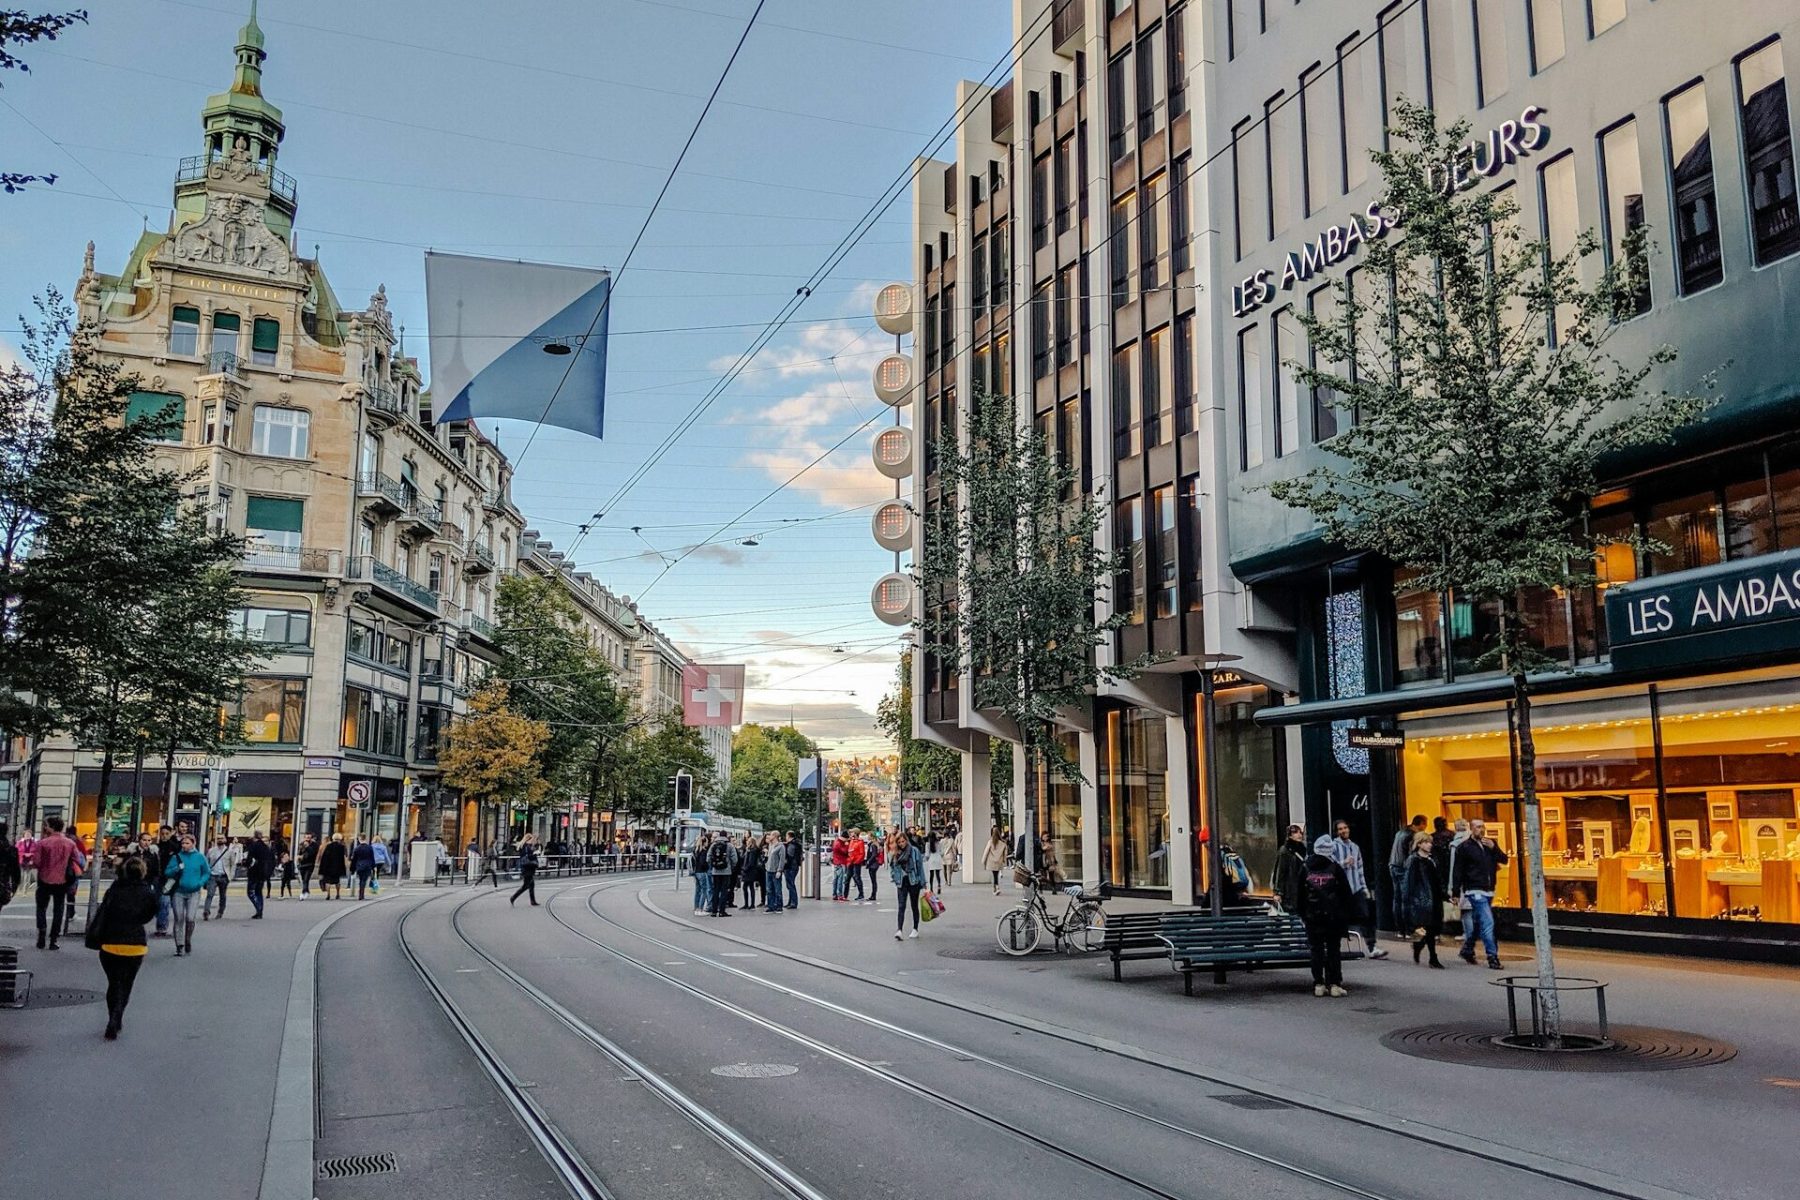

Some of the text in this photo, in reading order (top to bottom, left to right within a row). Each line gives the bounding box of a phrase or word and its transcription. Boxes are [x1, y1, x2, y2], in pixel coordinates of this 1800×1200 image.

[1231, 104, 1546, 317] LES AMBASSDEURS
[882, 288, 905, 610] IDEAL
[1628, 594, 1674, 636] LES
[1213, 672, 1241, 684] ZARA
[1362, 736, 1403, 745] AMBASSADEURS
[1351, 794, 1369, 811] 64
